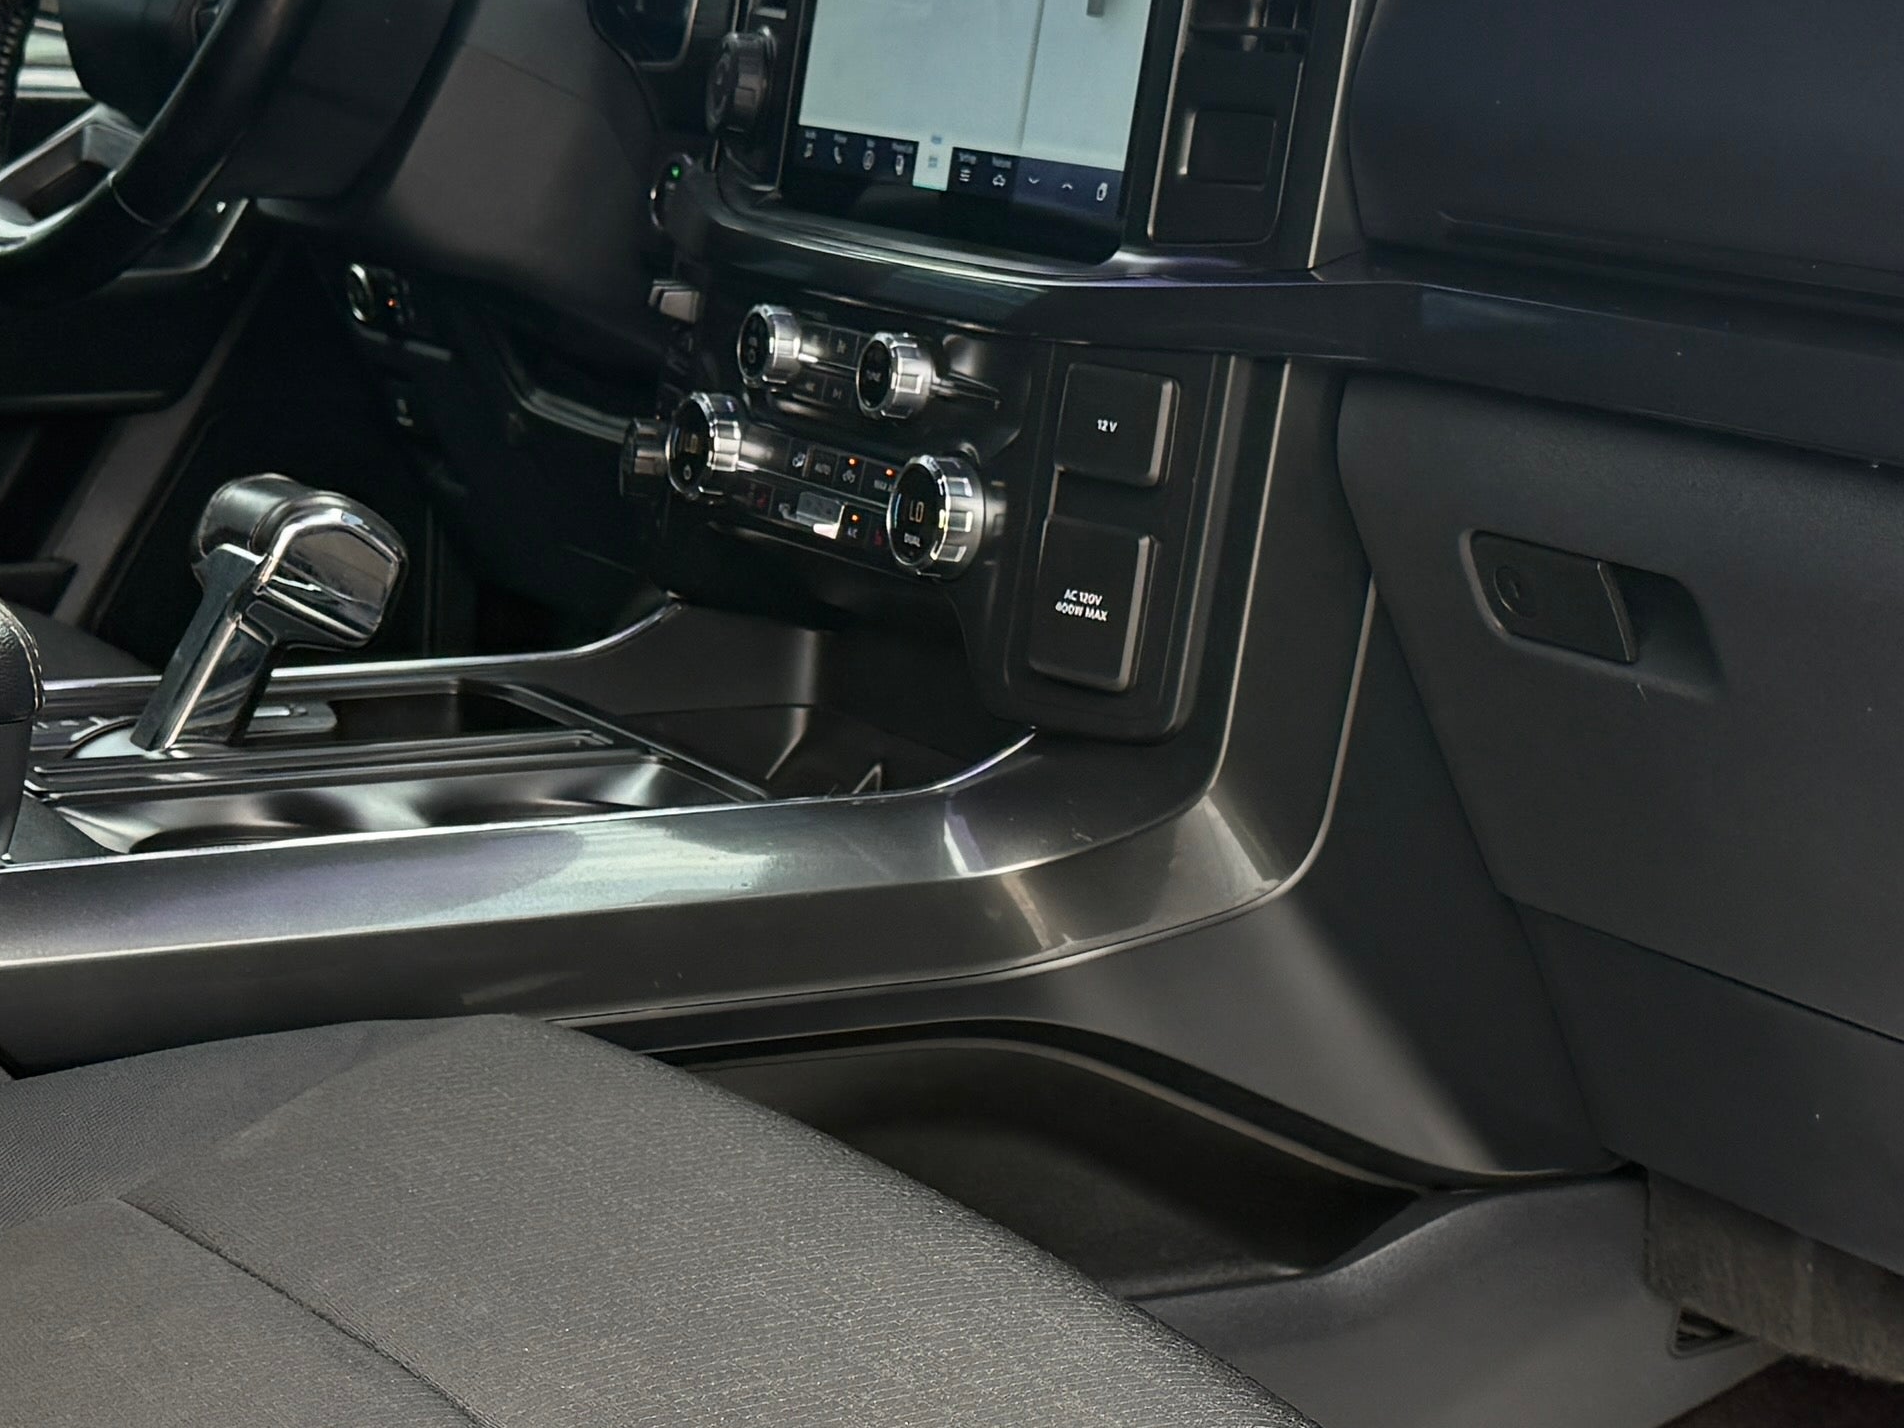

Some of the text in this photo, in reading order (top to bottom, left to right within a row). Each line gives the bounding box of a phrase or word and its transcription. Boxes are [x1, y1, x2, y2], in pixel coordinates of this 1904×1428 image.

[909, 499, 925, 523] LO
[903, 532, 921, 548] DUAL
[1063, 588, 1103, 606] AC 120V
[1084, 606, 1108, 622] MAX
